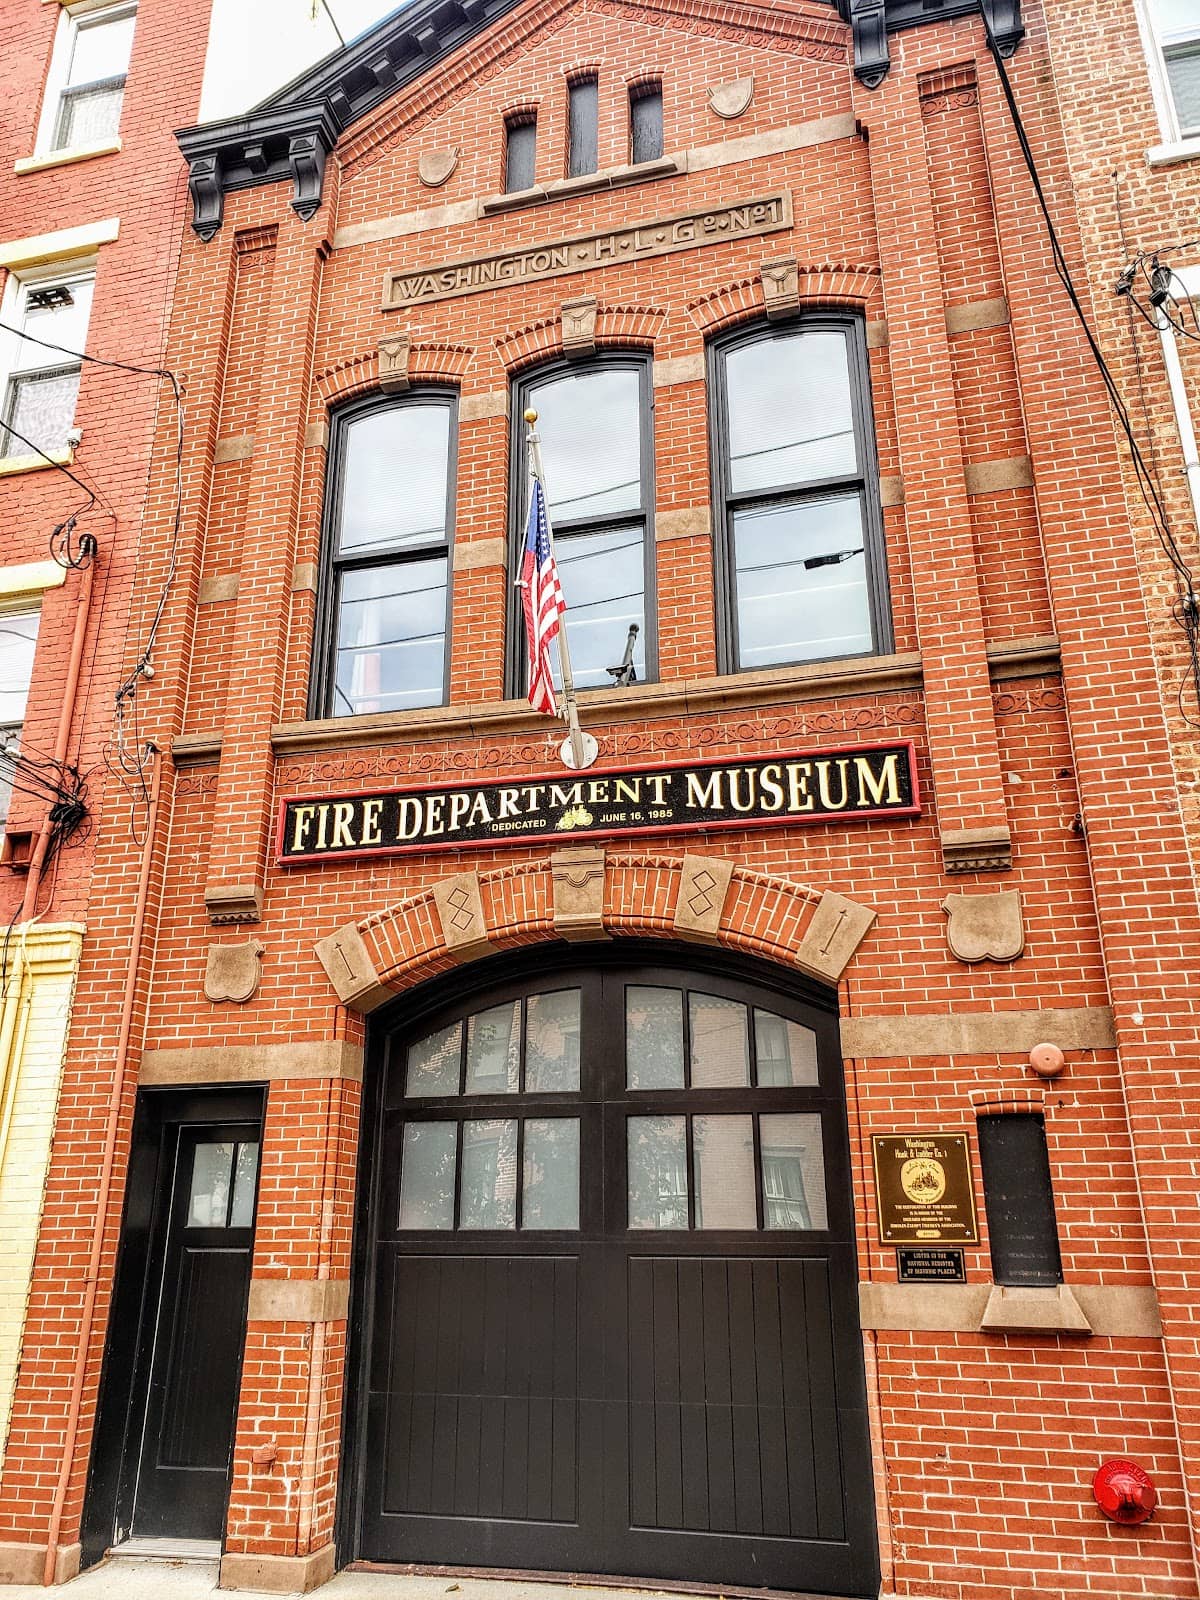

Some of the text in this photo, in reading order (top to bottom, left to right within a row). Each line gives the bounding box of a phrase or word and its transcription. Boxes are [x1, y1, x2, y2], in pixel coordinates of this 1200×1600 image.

[399, 246, 569, 299] WASHINGTON
[291, 754, 903, 852] FIRE DEPARTMENT MUSEUM
[491, 809, 673, 832] DEDICATED JUNE 16, 1985
